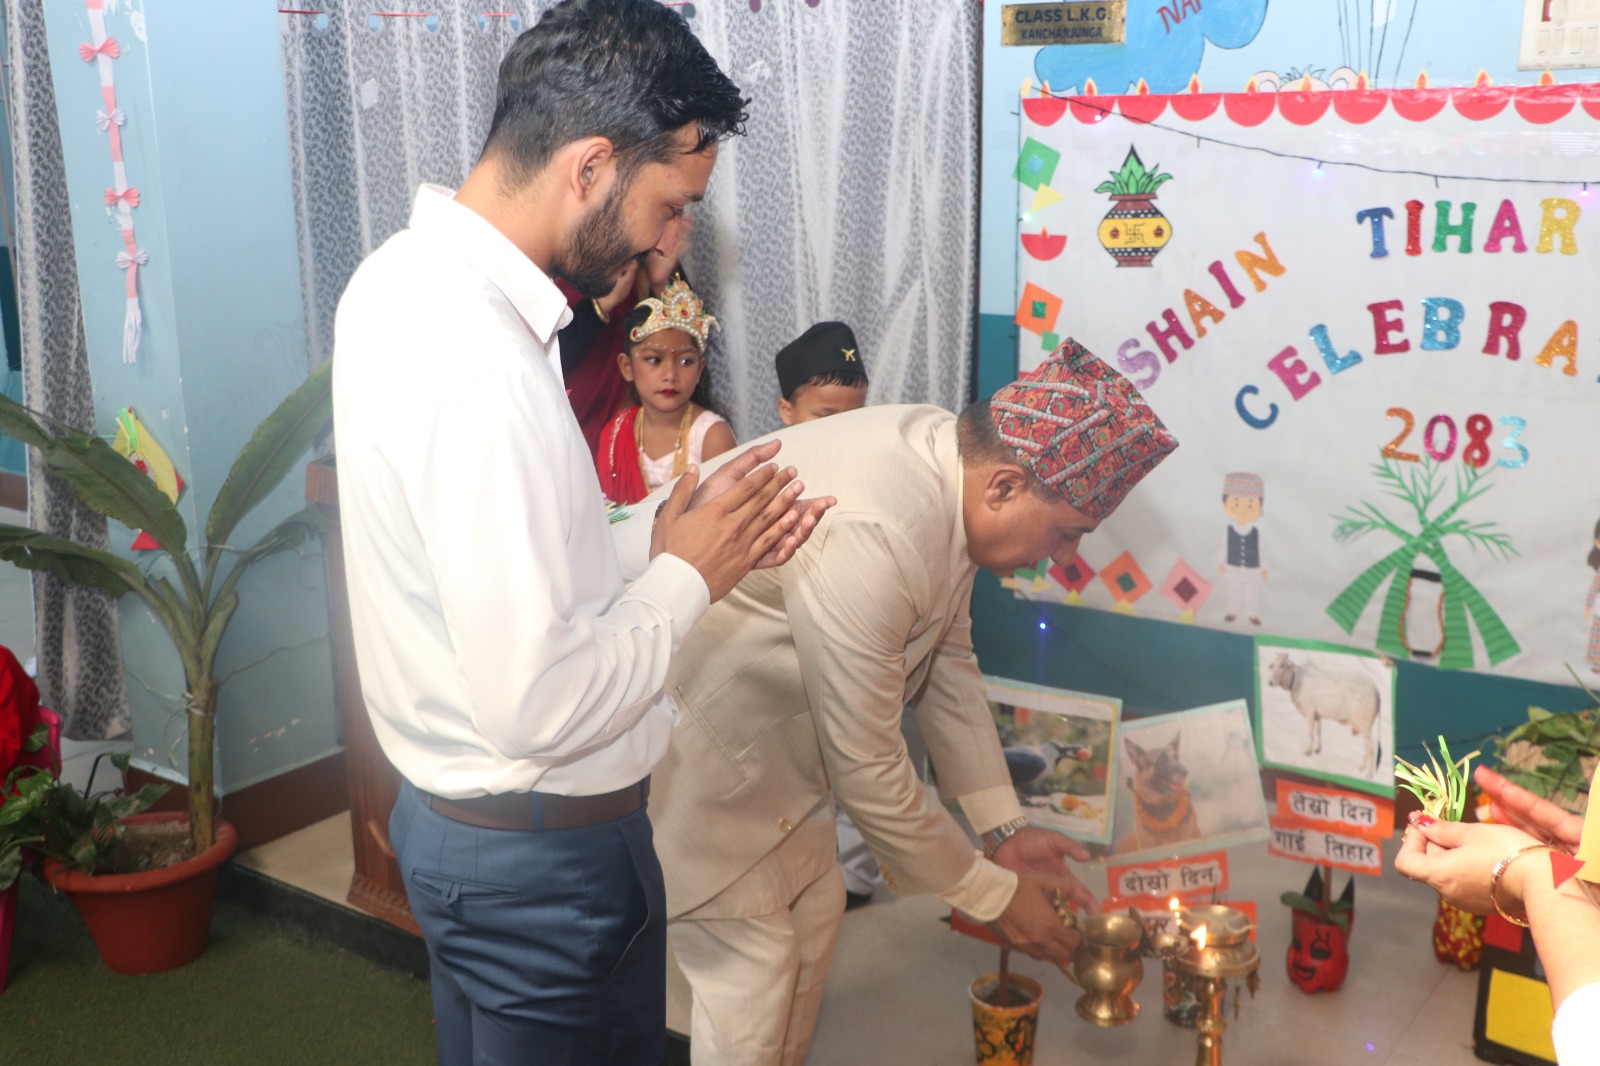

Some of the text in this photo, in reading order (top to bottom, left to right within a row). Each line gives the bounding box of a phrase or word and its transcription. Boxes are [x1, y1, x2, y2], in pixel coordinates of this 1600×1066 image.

[1015, 7, 1111, 23] CLASS L.K.G.
[1021, 26, 1104, 40] KANCHANJUNGA
[1116, 197, 1582, 391] SHAIN TIHAR
[1234, 296, 1600, 431] CELEBRA
[1382, 407, 1530, 470] 2083
[1339, 797, 1374, 823] दिन
[1274, 829, 1376, 864] गाई तिहार
[1181, 865, 1216, 888] दिन
